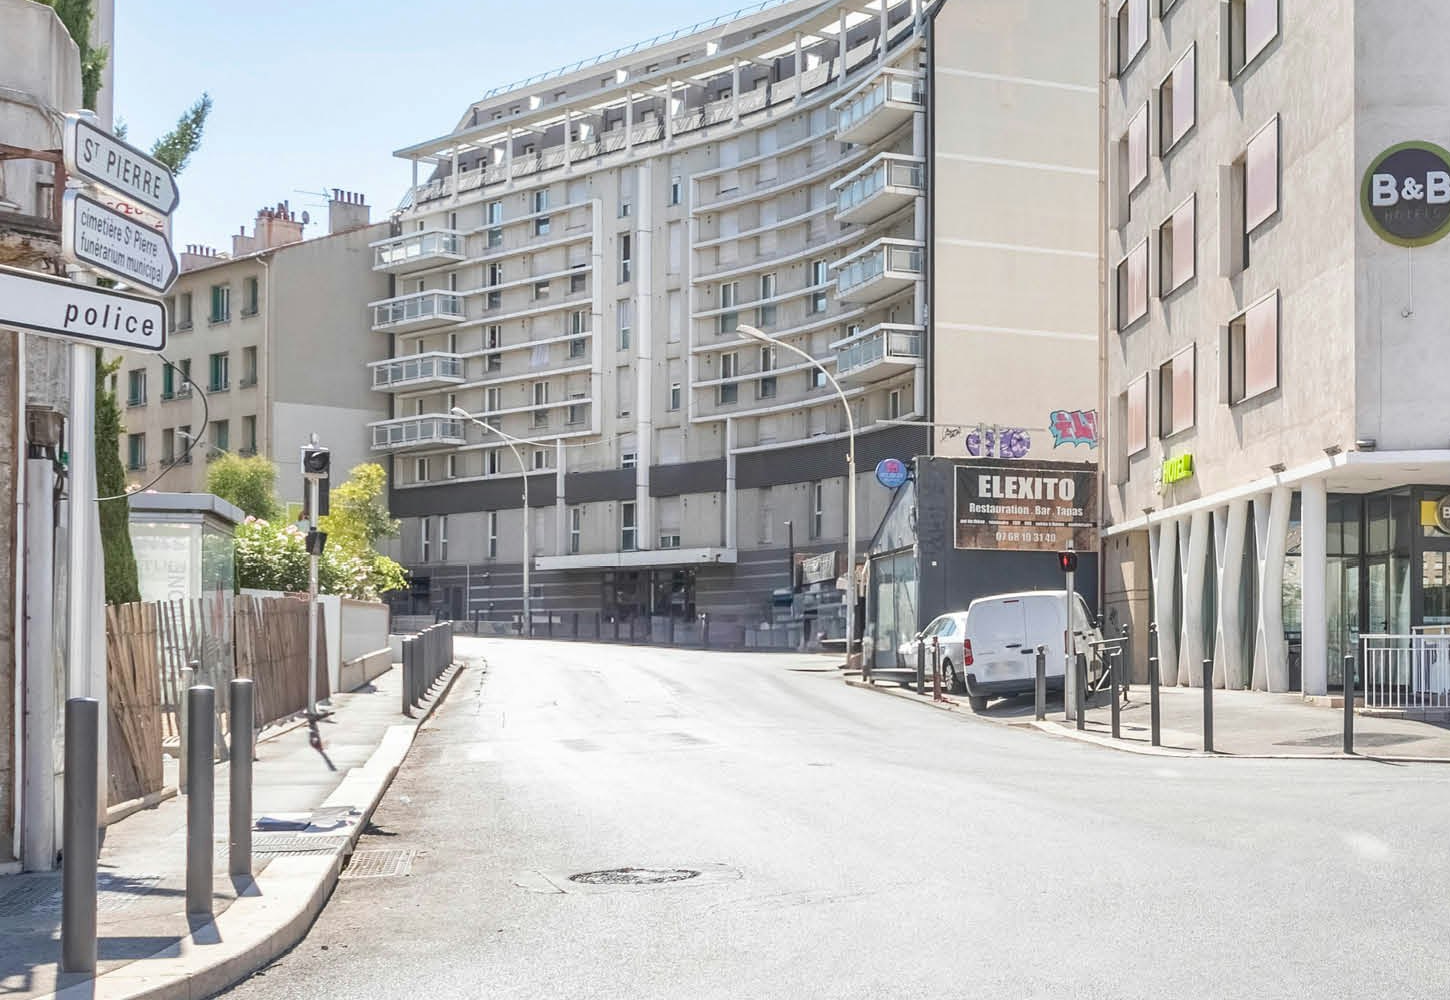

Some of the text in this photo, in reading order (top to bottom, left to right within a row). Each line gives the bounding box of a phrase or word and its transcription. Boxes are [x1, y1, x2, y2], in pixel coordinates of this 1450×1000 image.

[107, 149, 161, 200] PIERRE
[81, 208, 122, 242] cimetière
[134, 230, 158, 257] Pierre
[80, 231, 164, 283] funérarium municipal
[64, 303, 155, 336] police
[1163, 454, 1193, 484] HOTEL
[978, 475, 1076, 501] ELEXITO
[969, 502, 1083, 517] Restauration Bar Tapas
